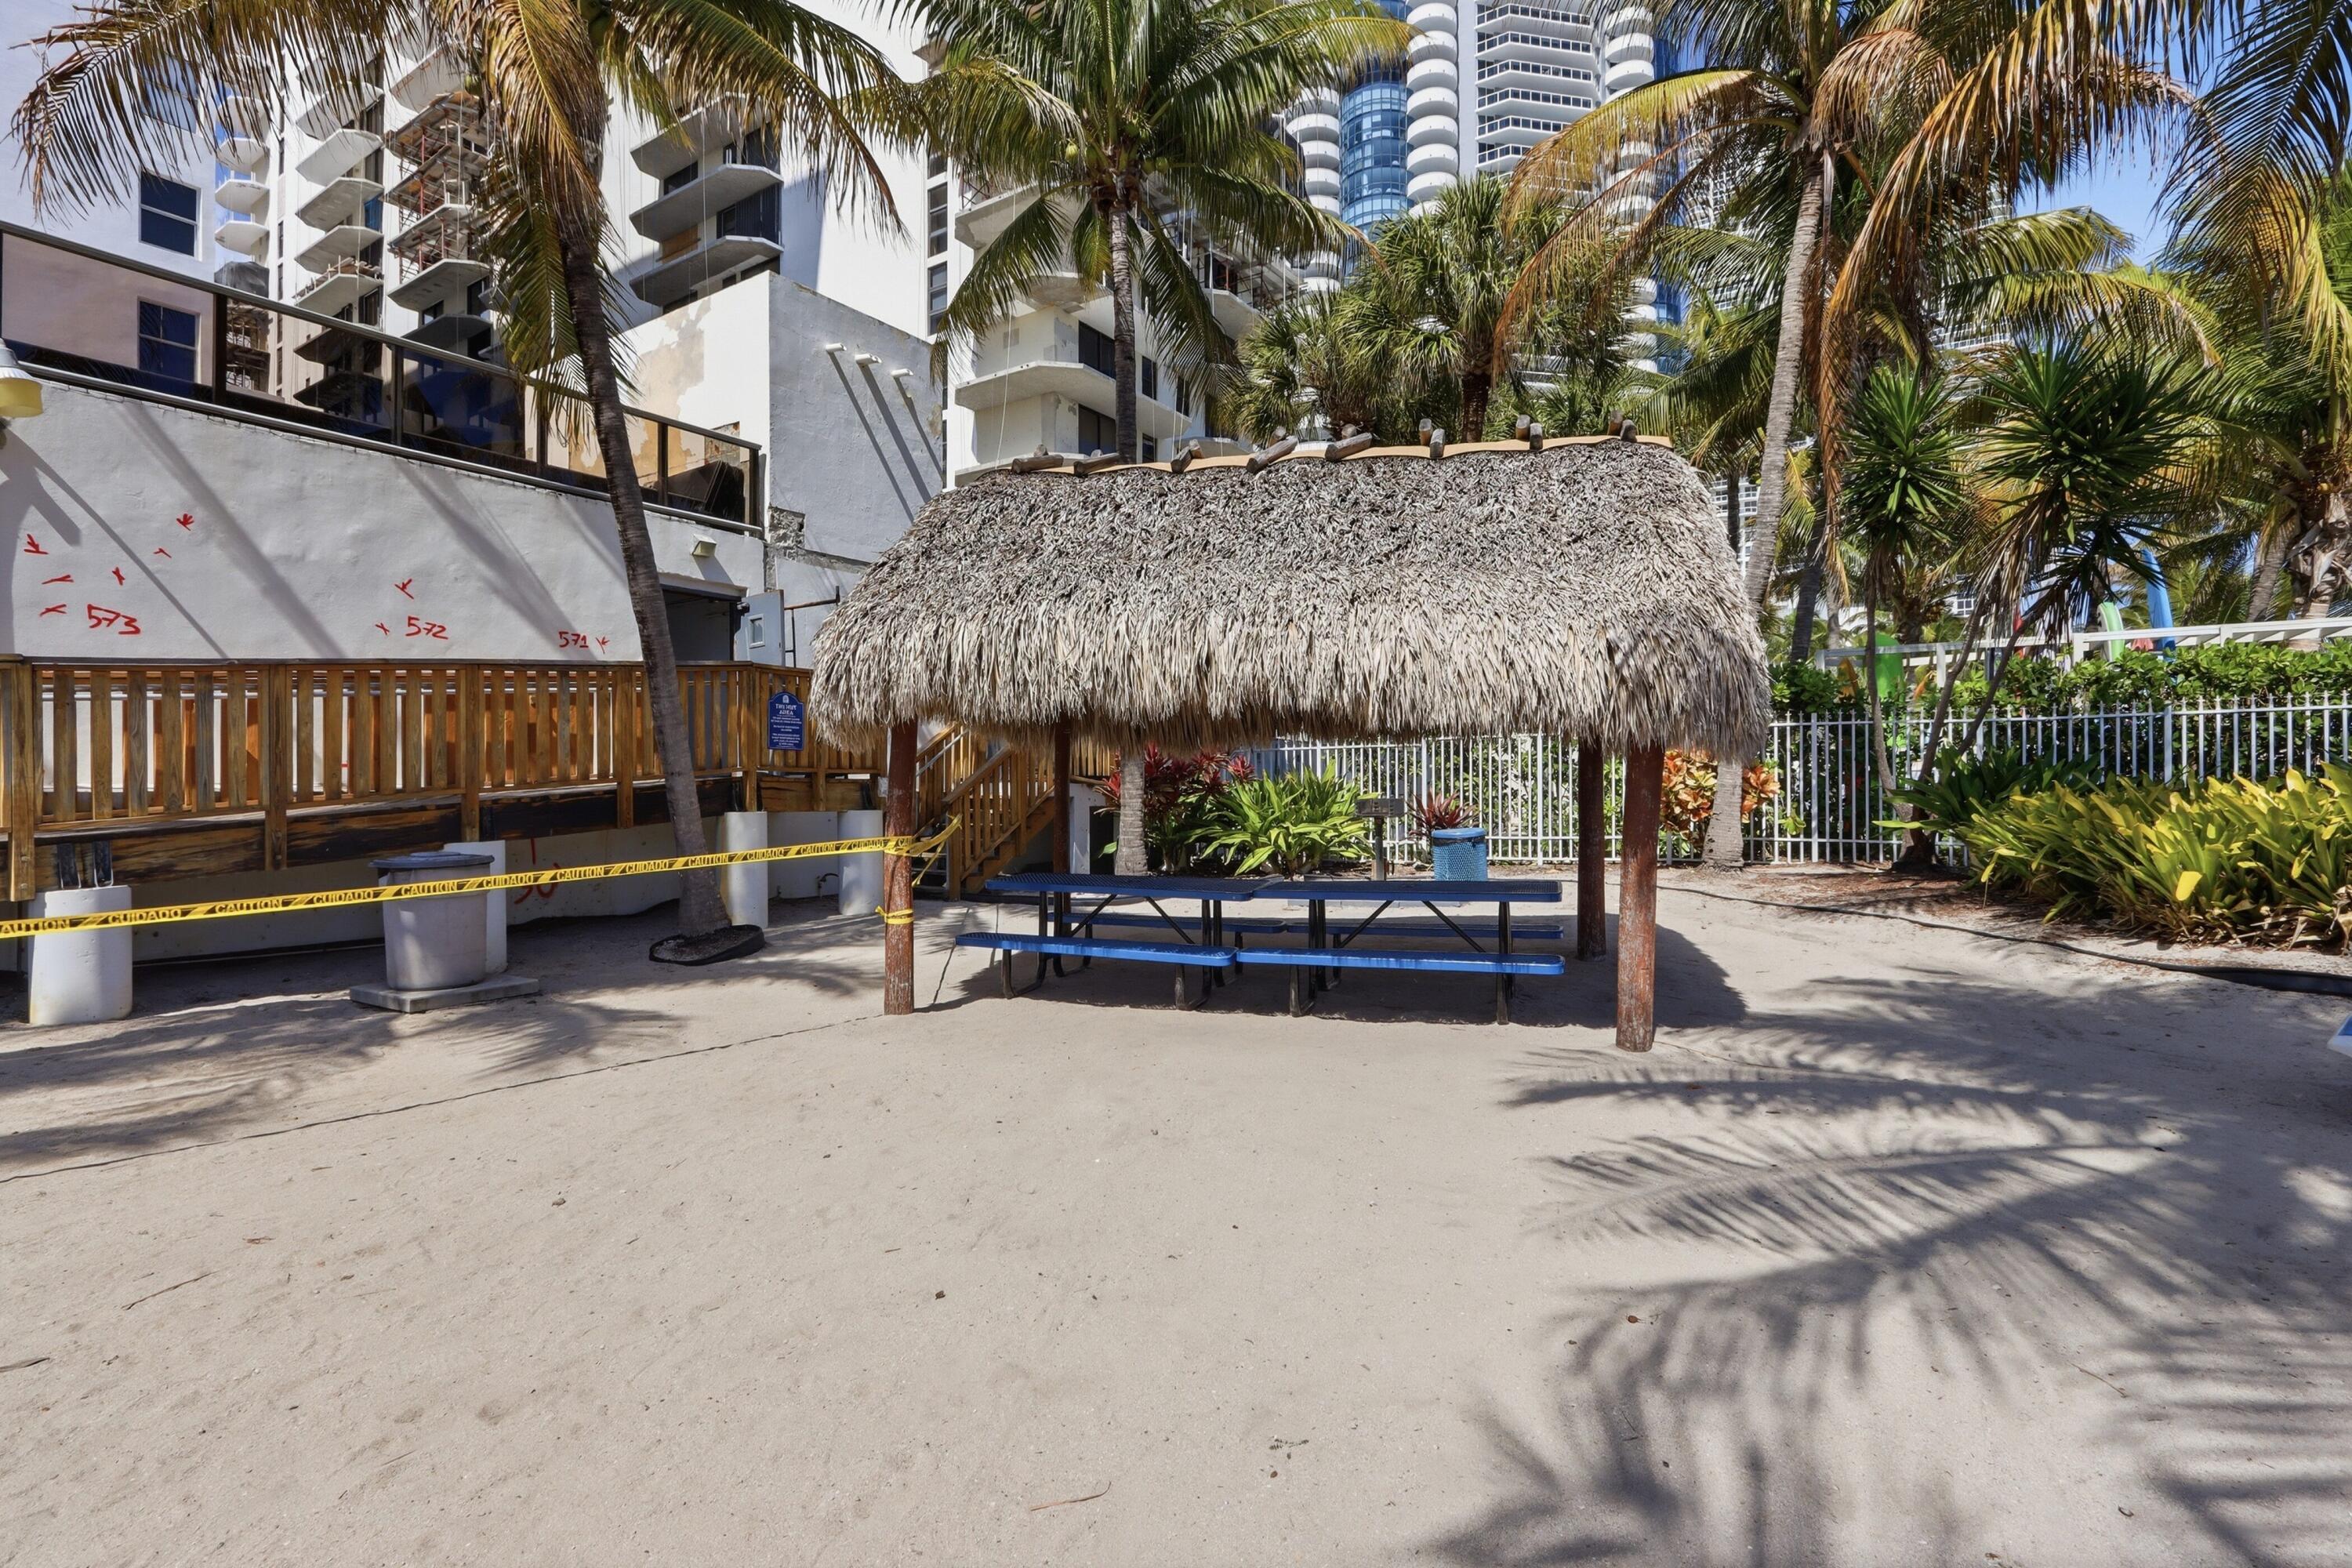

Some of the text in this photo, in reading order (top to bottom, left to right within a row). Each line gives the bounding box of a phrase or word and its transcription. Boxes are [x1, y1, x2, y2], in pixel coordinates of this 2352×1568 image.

[87, 604, 140, 635] 573
[405, 615, 448, 640] 572
[558, 630, 589, 648] 571
[0, 919, 71, 935] AUTION
[108, 908, 182, 924] CUIDADO
[215, 898, 282, 914] CAUTION
[313, 889, 374, 905] CUIDADO
[401, 881, 457, 896] CAUTION
[482, 874, 534, 888] CUIDADO
[557, 867, 604, 880] CAUTION
[626, 860, 669, 873] CUIDADO
[688, 854, 728, 867] CAUTION
[800, 843, 836, 855] CAUTION
